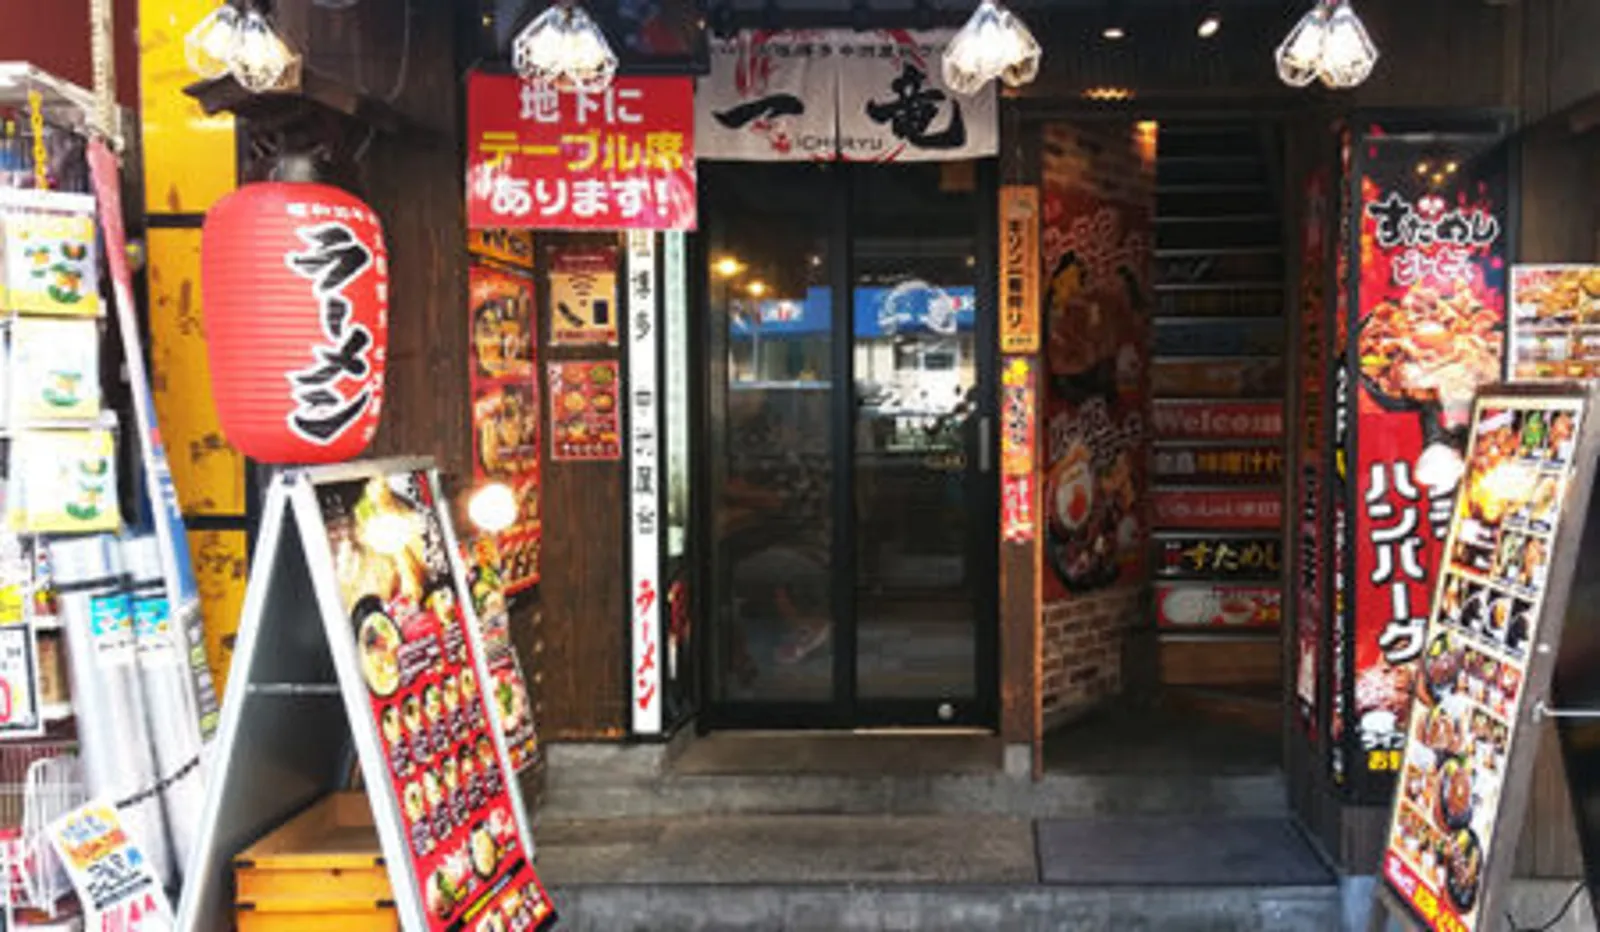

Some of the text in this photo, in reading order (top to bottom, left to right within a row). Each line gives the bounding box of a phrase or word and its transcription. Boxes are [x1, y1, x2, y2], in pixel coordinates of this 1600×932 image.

[519, 82, 644, 124] 地下に
[480, 130, 684, 171] テーブル席
[491, 178, 670, 217] あります!
[1365, 192, 1499, 247] すためし
[284, 221, 374, 446] ラーメン
[1181, 541, 1280, 571] すためし
[636, 578, 656, 710] ラーメン
